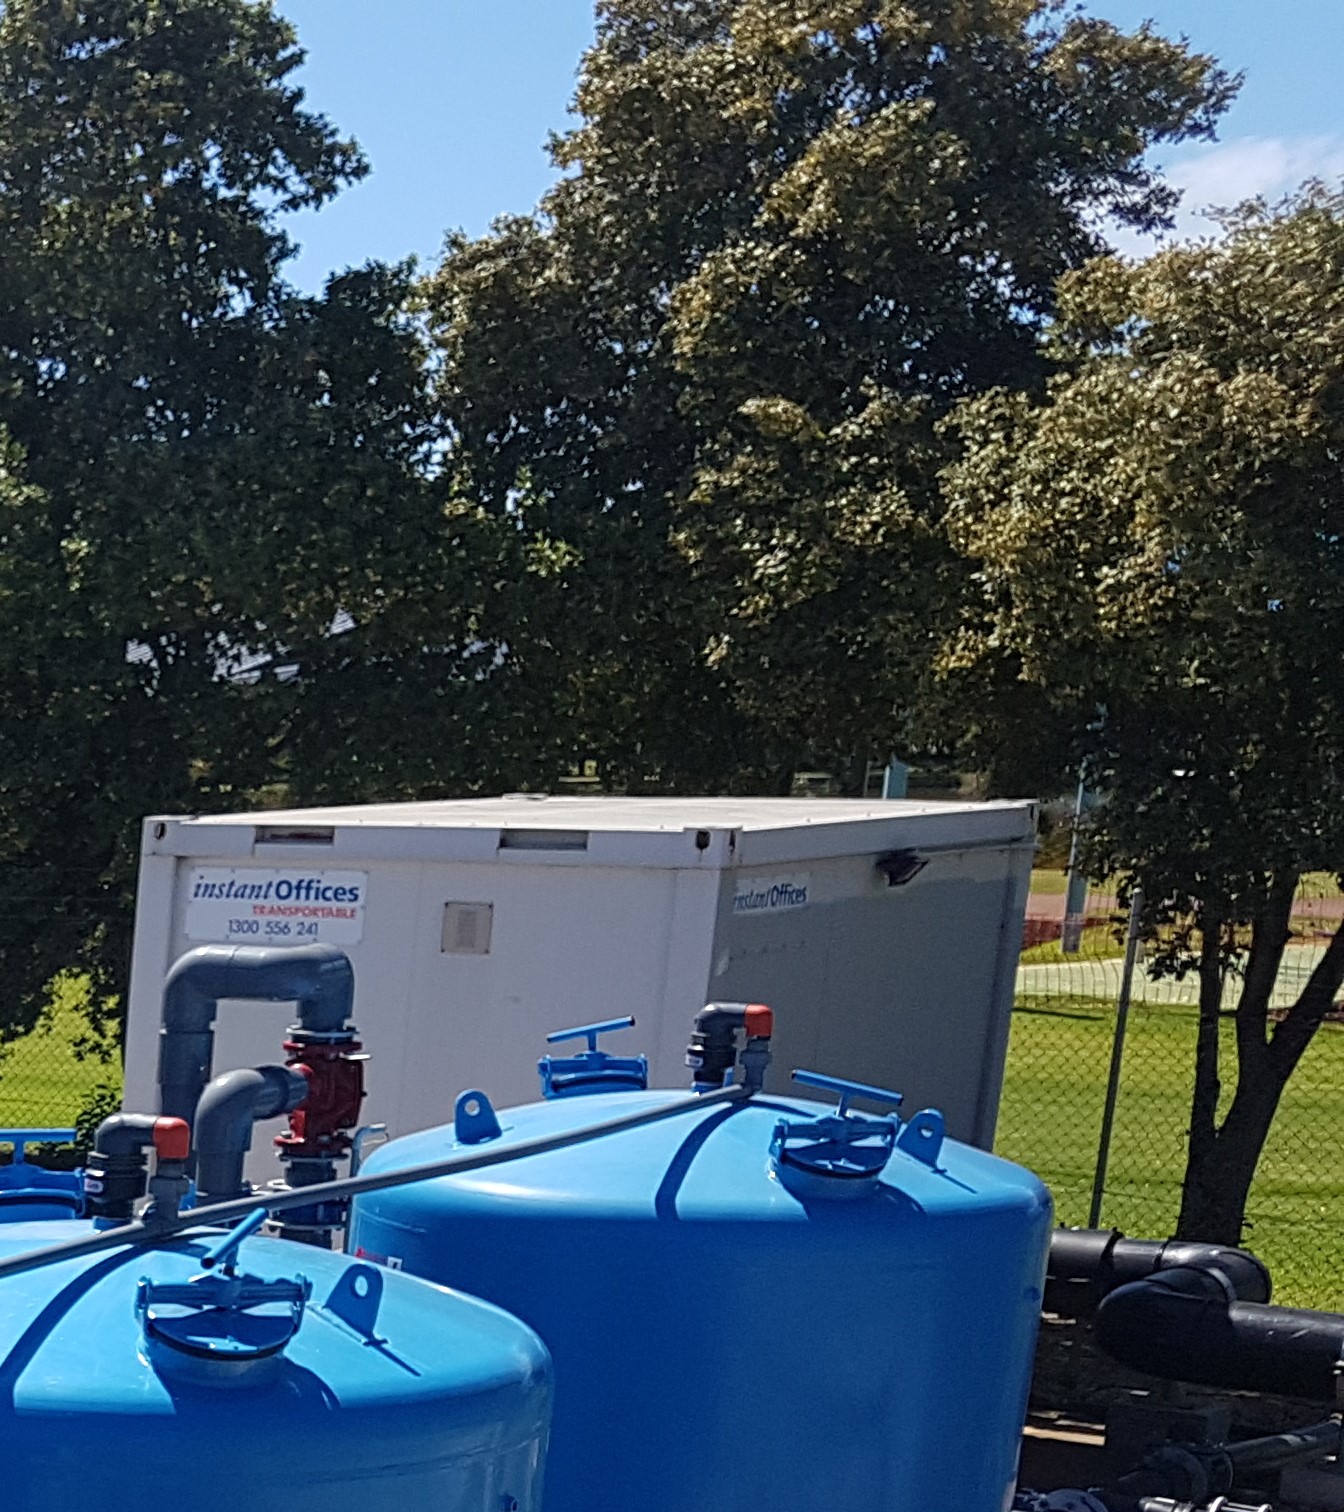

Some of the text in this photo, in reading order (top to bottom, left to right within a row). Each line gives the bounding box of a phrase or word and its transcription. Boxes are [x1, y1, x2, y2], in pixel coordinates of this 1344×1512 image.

[252, 904, 357, 919] TRANSPORTABLE
[228, 919, 319, 936] 1300 556 241
